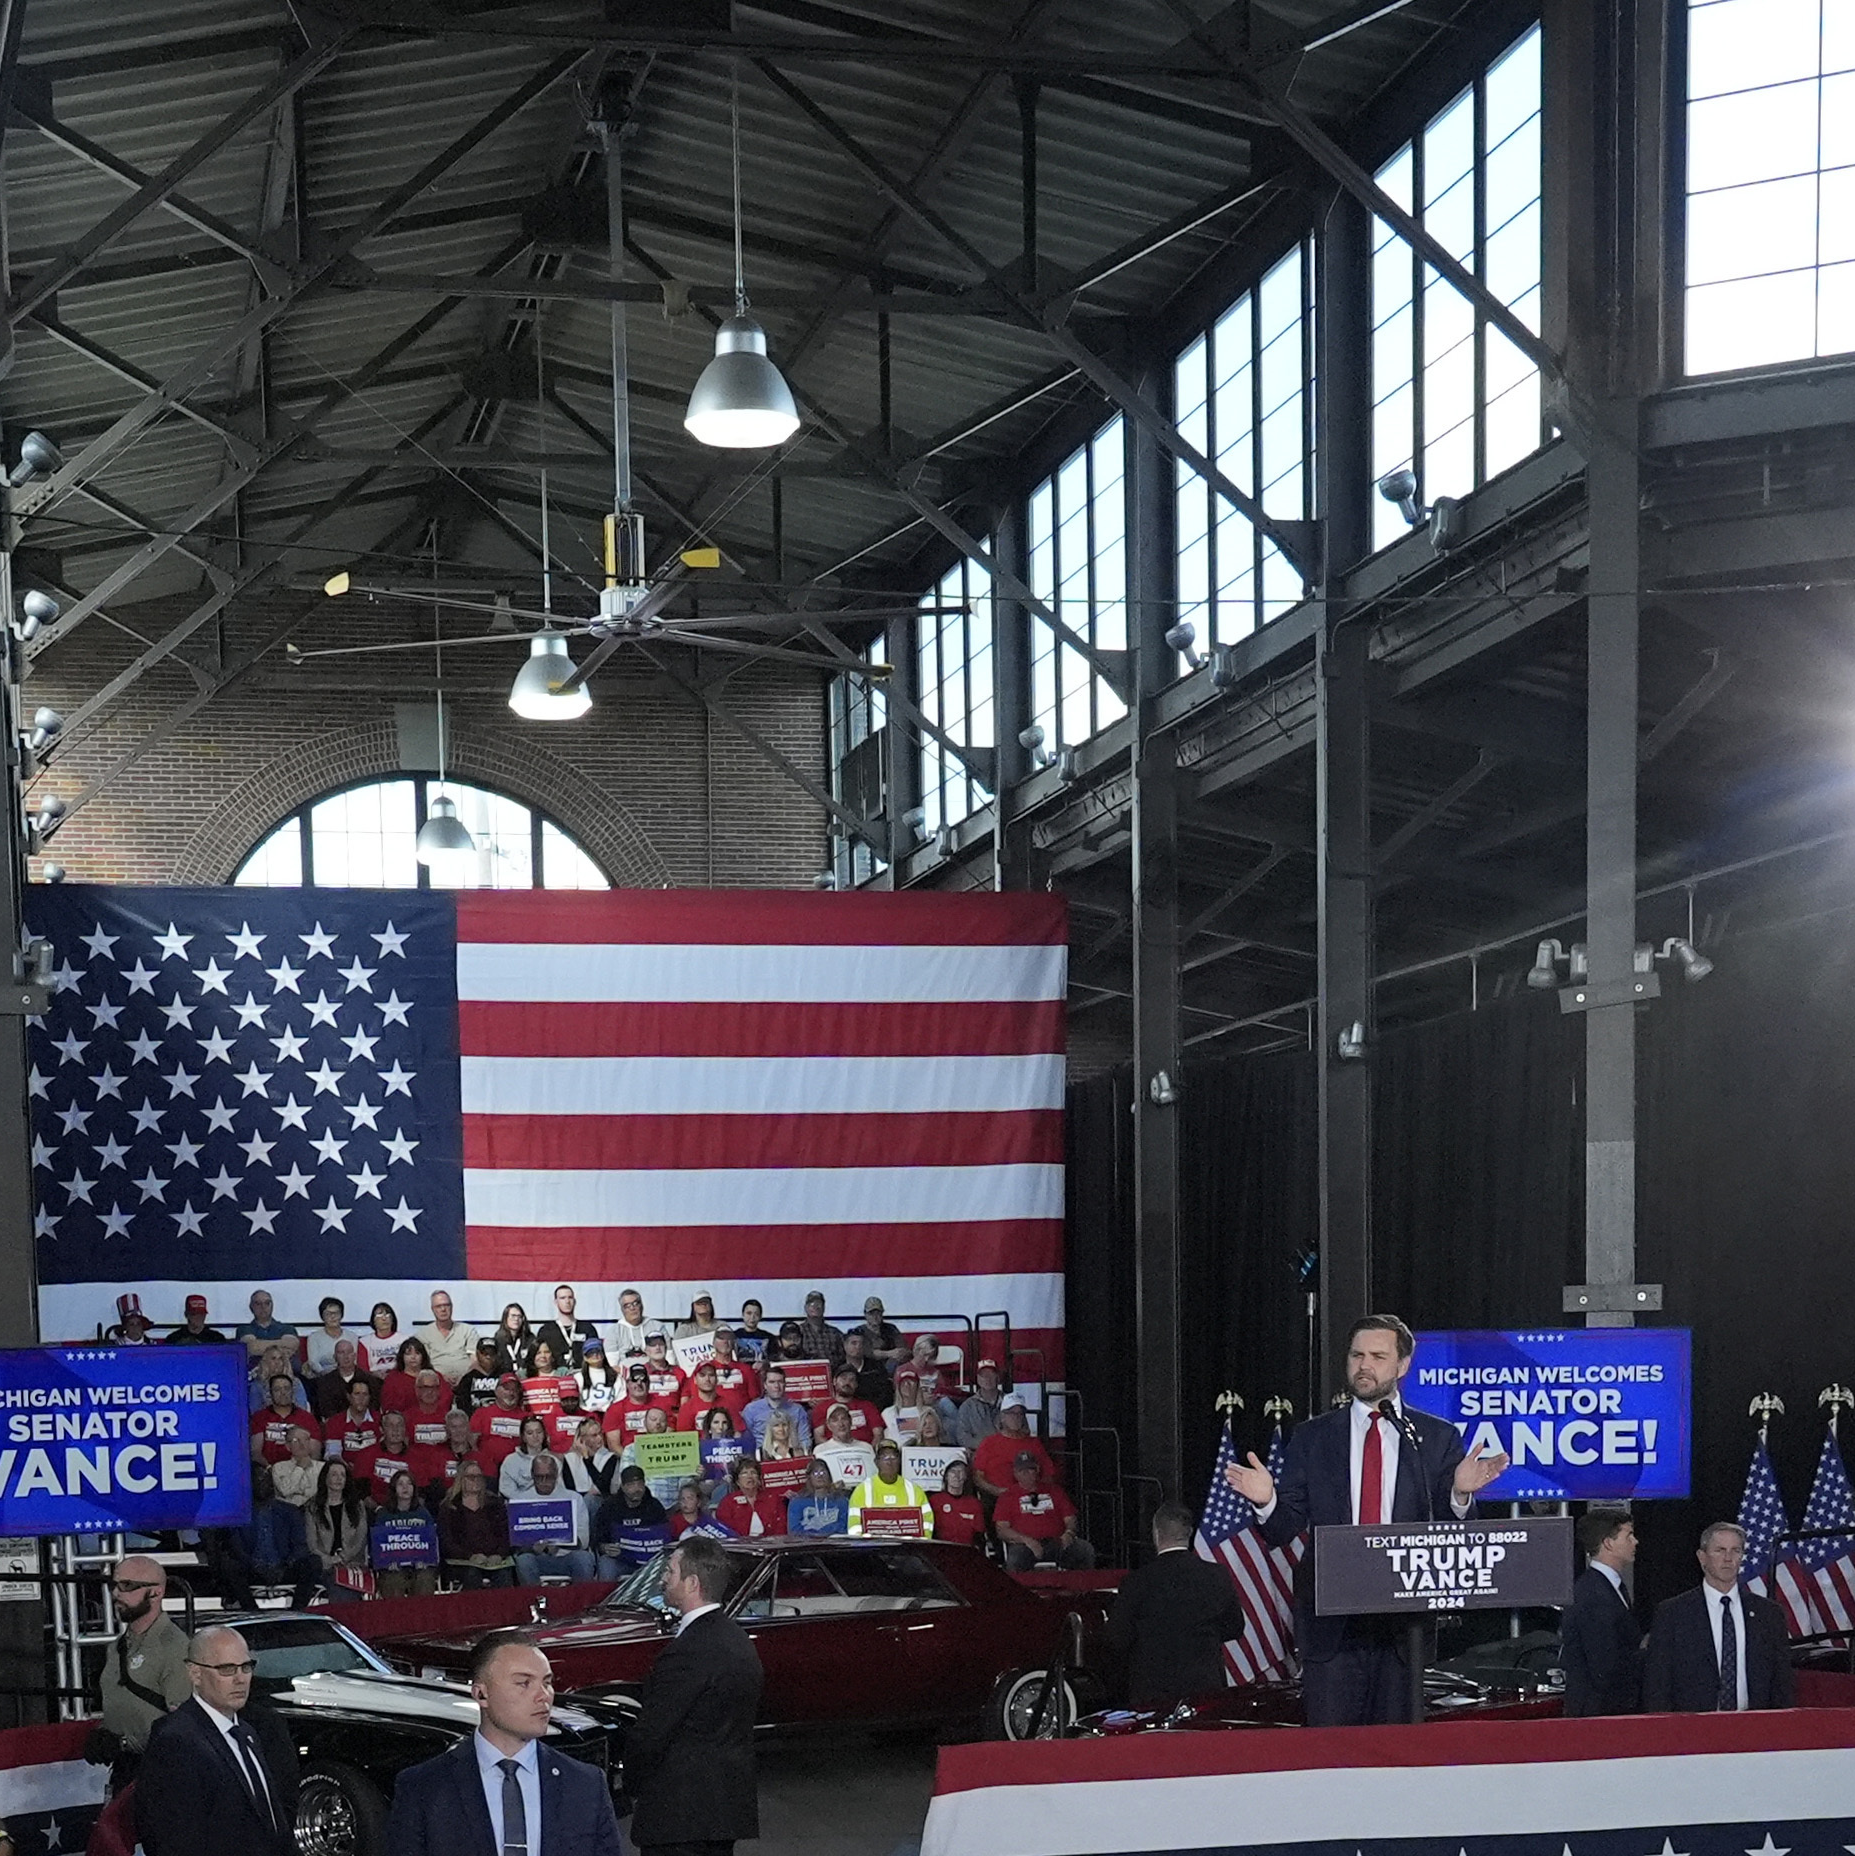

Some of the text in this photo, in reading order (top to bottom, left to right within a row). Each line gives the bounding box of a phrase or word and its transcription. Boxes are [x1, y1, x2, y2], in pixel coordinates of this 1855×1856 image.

[682, 1344, 714, 1356] TRUM
[688, 1351, 716, 1363] VANC
[1419, 1365, 1664, 1385] MICHIGAN WELCOMES
[87, 1383, 220, 1405] WELCOMES
[1460, 1389, 1622, 1416] SENATOR
[8, 1410, 179, 1442] SENATOR
[641, 1441, 693, 1450] TEAMSTERS
[1462, 1420, 1658, 1466] ANCE!
[712, 1446, 743, 1456] PEACE
[648, 1454, 687, 1463] TRUMP
[909, 1458, 946, 1468] TRUM
[843, 1464, 863, 1477] 47
[914, 1469, 944, 1477] VANC
[899, 1518, 918, 1526] FIRST
[388, 1533, 421, 1542] PEACE
[644, 1538, 664, 1547] BACK
[1364, 1531, 1527, 1548] TEXT MICHIGAN TO 88022
[380, 1541, 429, 1552] THROUGH
[1386, 1546, 1506, 1572] TRUMP
[1400, 1568, 1492, 1590] VANCE
[1416, 1590, 1447, 1598] AMERICA
[1428, 1597, 1465, 1609] 2024
